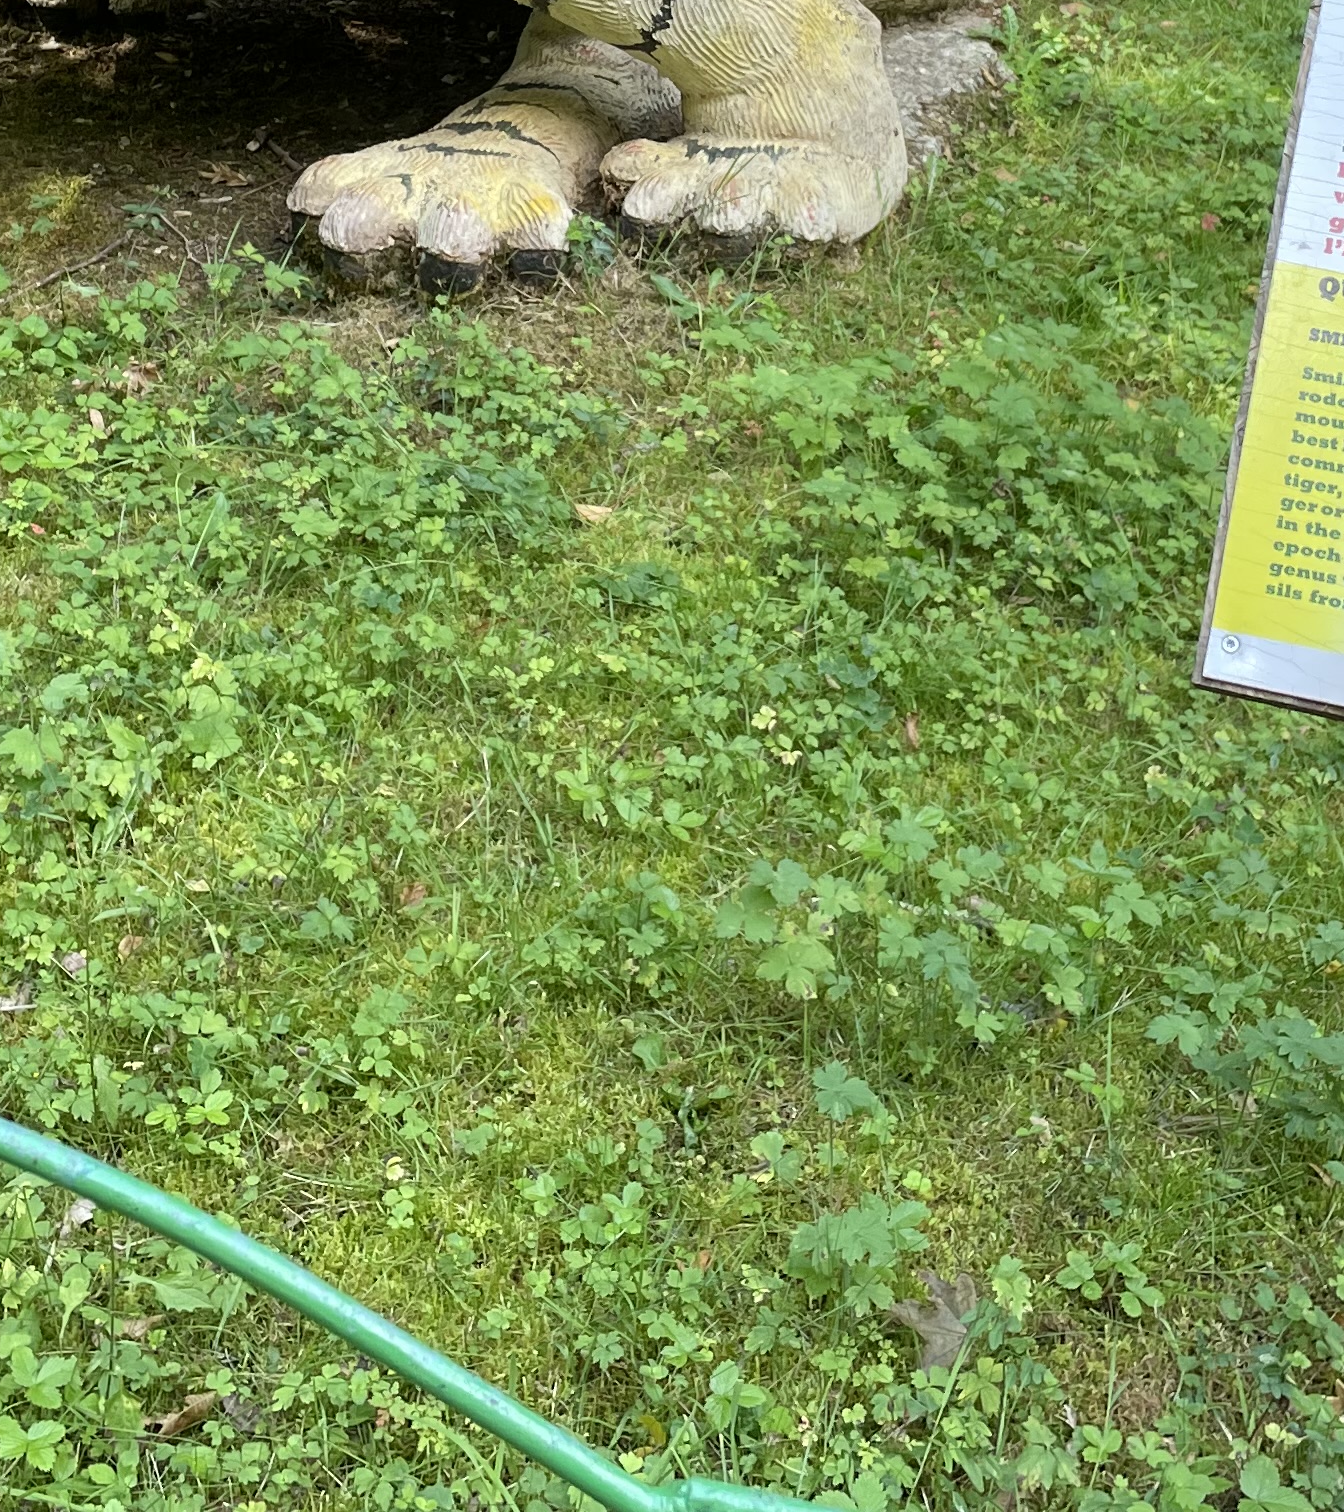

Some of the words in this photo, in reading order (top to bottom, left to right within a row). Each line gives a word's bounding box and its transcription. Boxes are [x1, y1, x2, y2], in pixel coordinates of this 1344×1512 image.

[1275, 517, 1299, 533] in
[1304, 522, 1342, 541] the
[1272, 540, 1342, 564] epoch
[1264, 582, 1303, 601] sils
